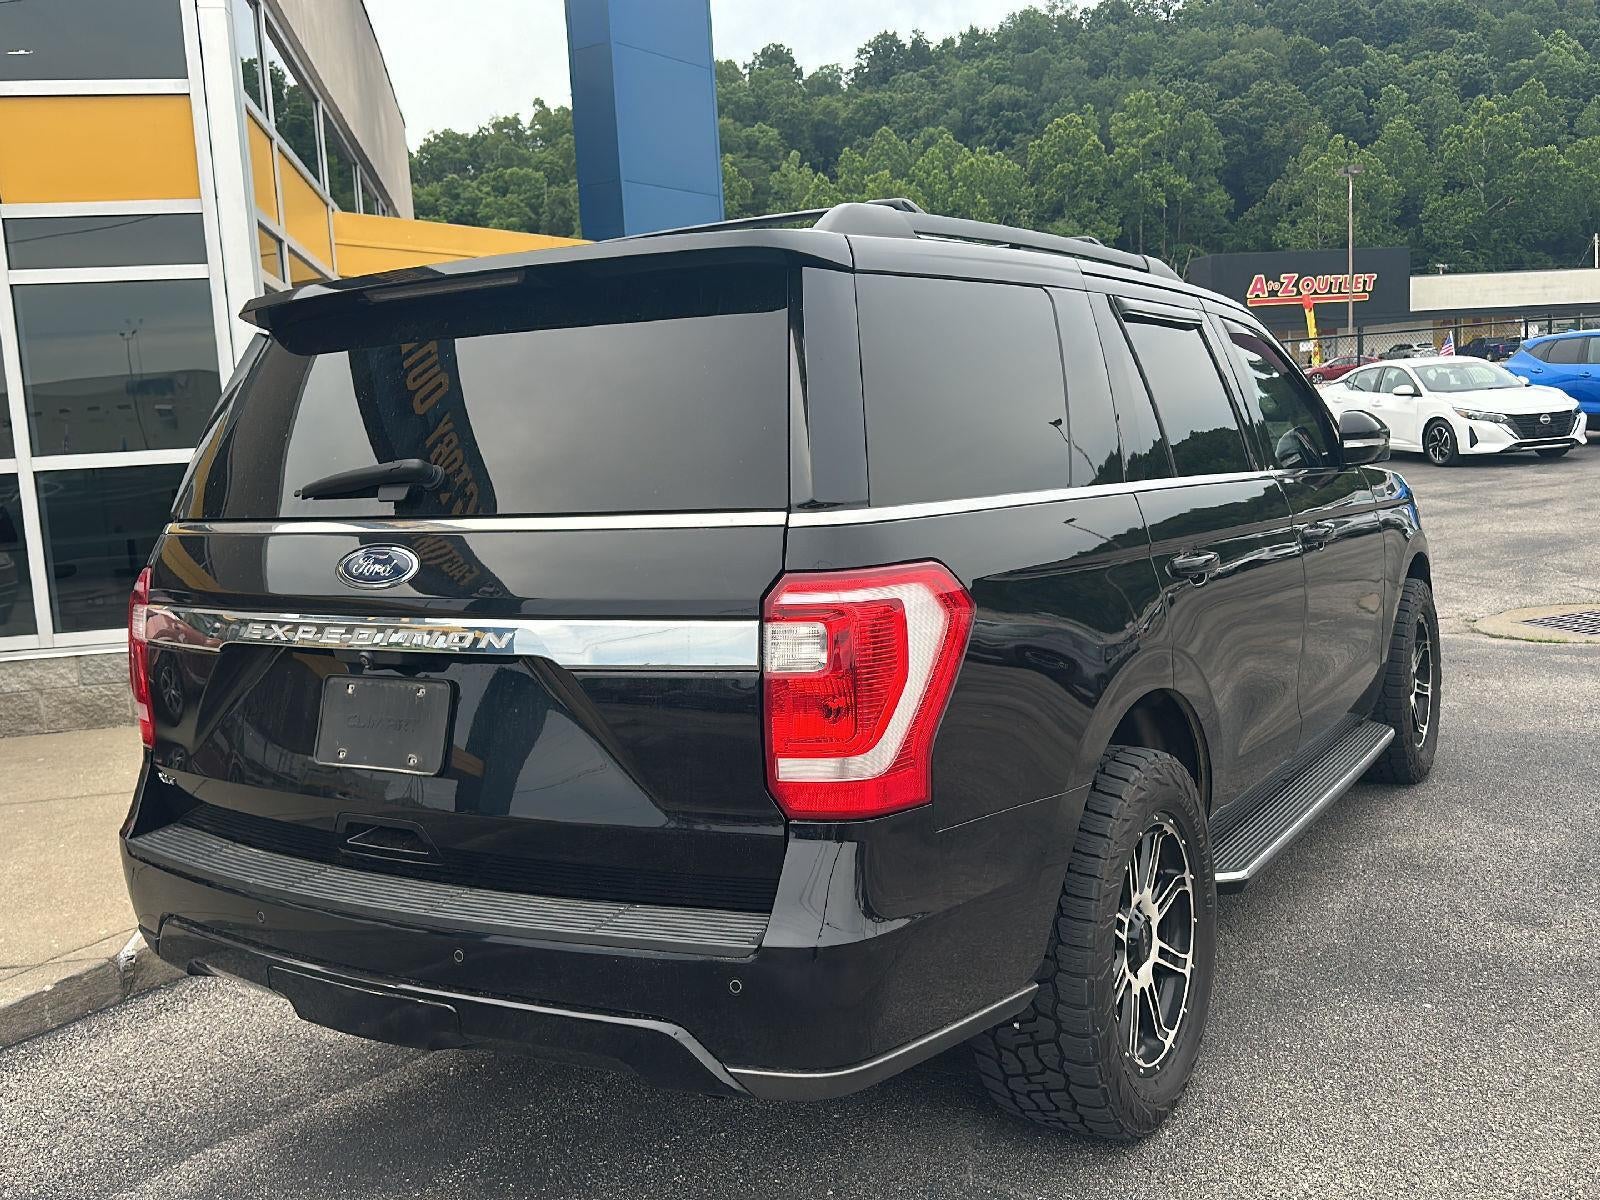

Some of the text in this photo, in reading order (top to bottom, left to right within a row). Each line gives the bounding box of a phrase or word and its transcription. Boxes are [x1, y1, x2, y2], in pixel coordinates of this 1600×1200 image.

[1299, 273, 1378, 295] OUTLET
[352, 556, 398, 577] Ford
[243, 622, 515, 649] EXPEDITION
